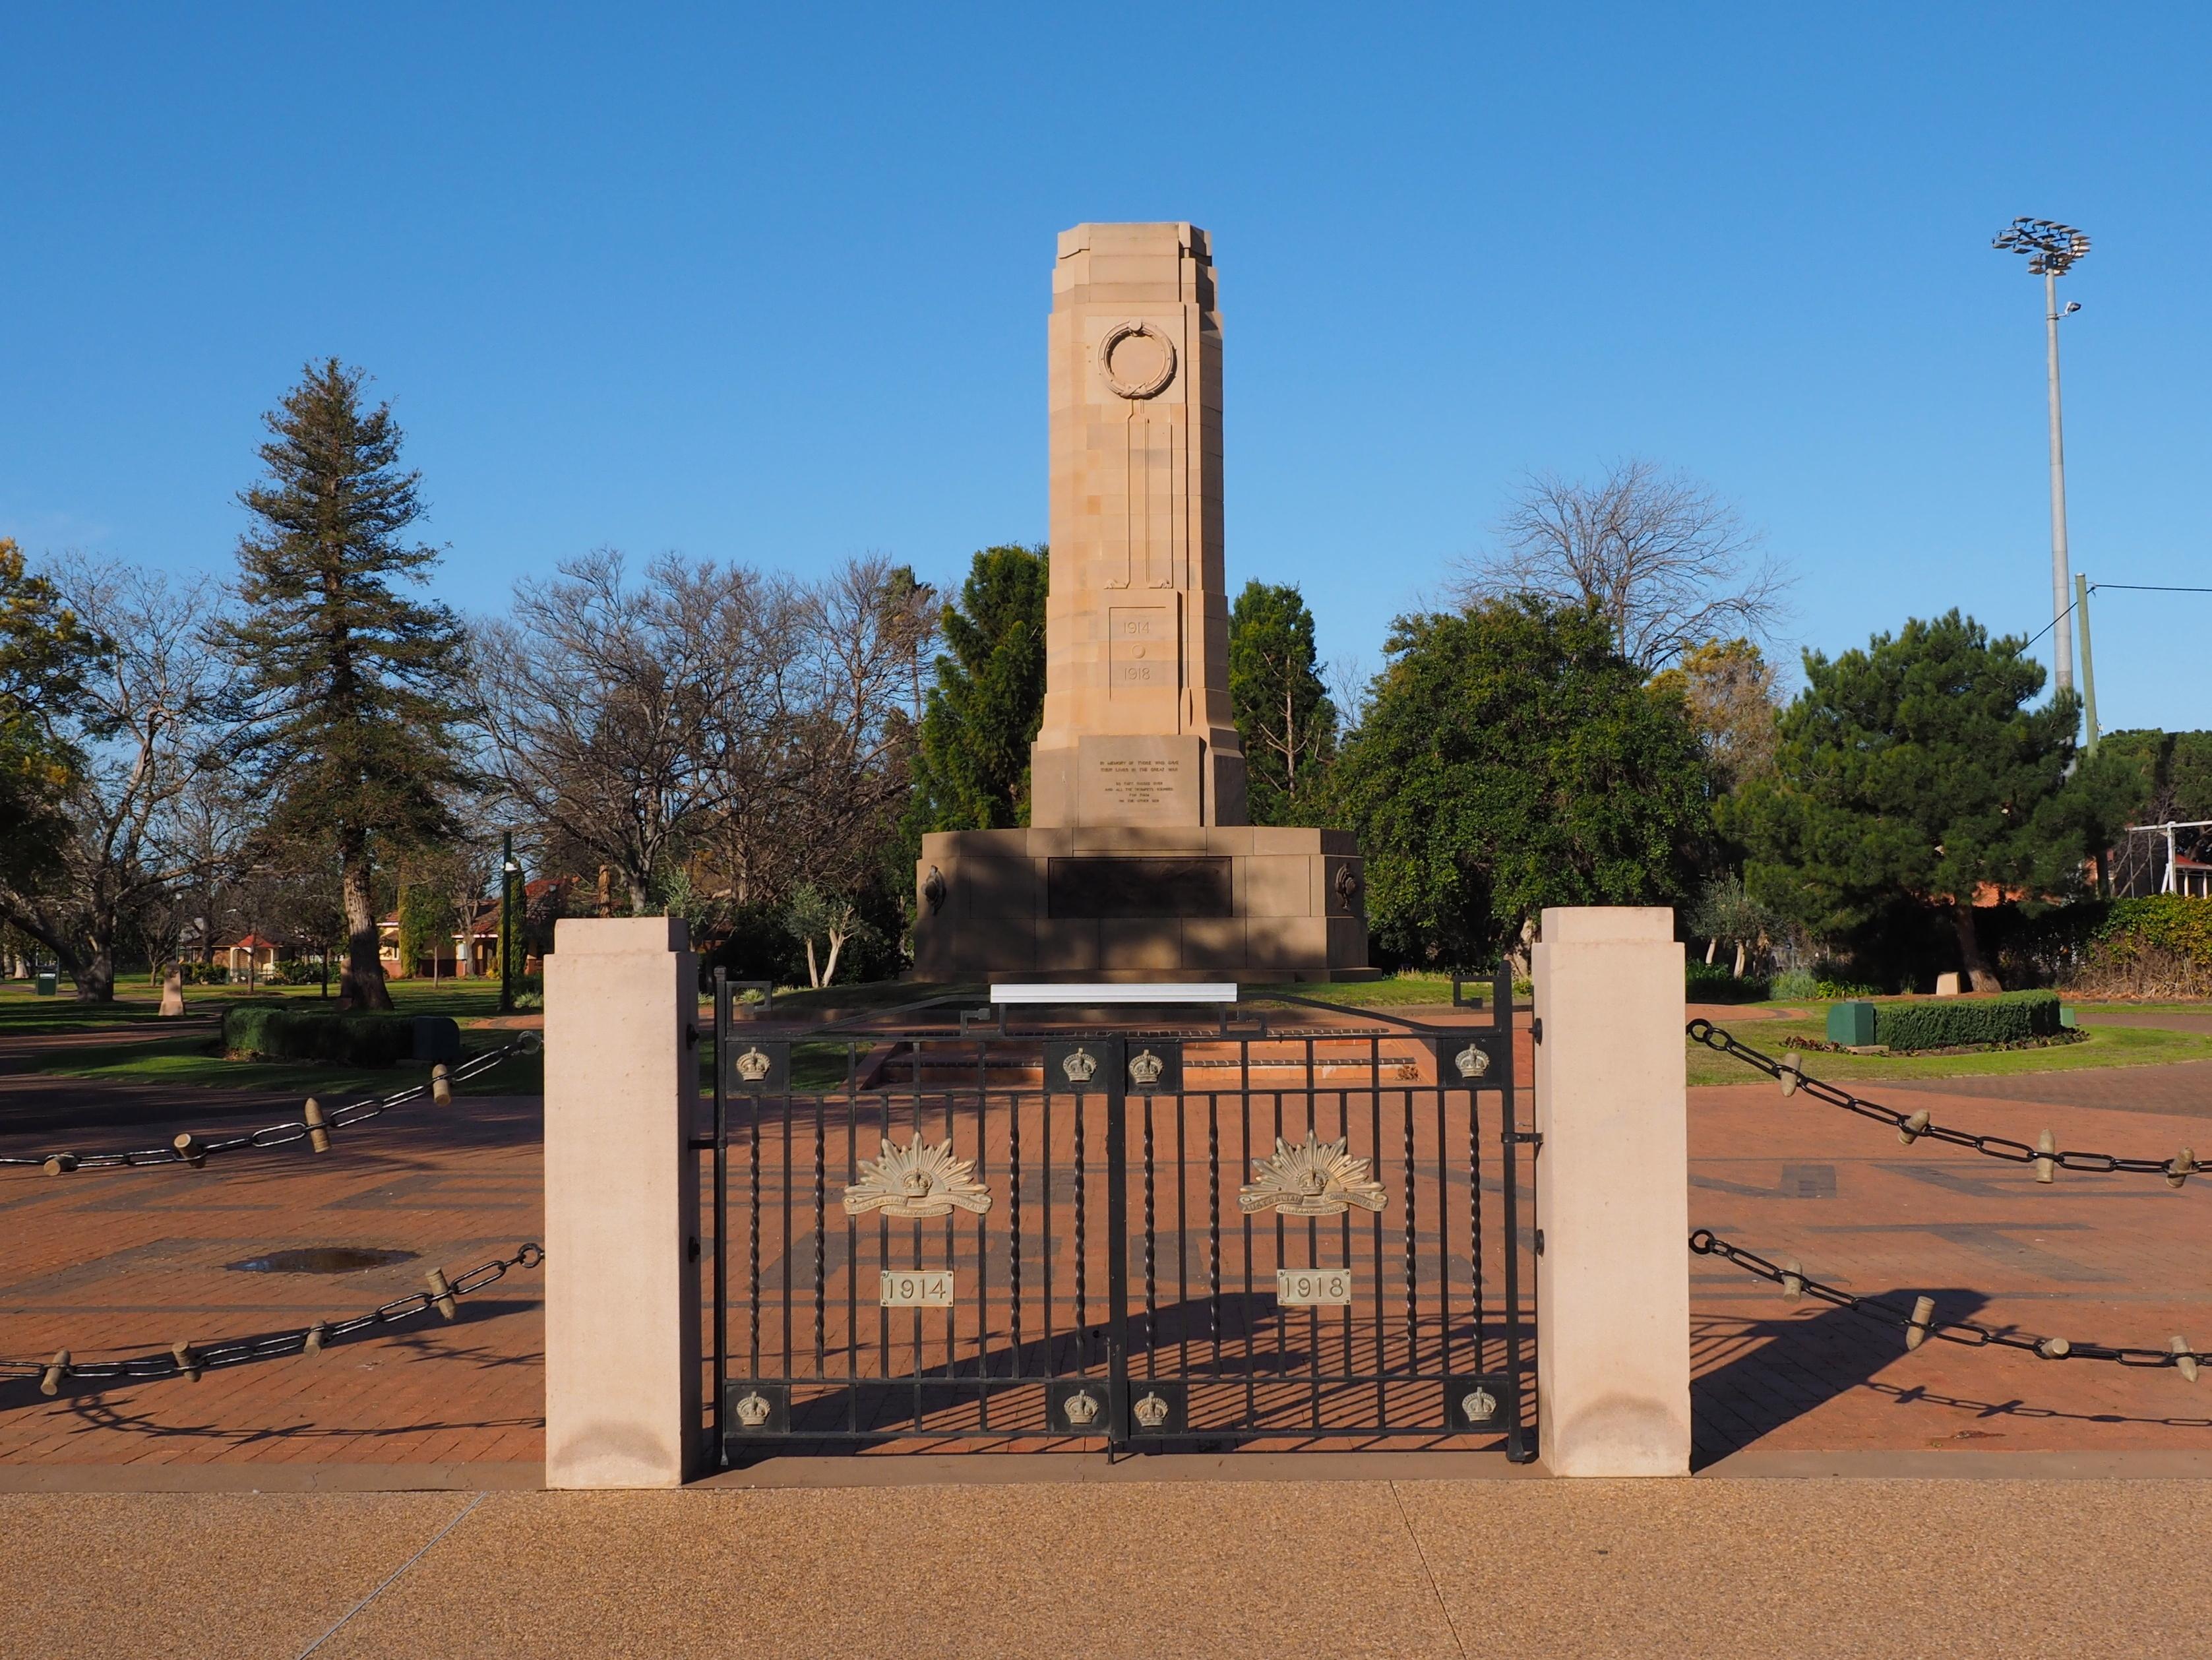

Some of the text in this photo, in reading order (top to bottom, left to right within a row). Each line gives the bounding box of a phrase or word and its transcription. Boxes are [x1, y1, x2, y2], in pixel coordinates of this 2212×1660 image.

[1124, 622, 1150, 634] 1914
[1124, 667, 1151, 680] 1918
[1243, 1194, 1385, 1212] AUSTRALIAN COMMONWEALTH
[1277, 1206, 1314, 1214] MILITARY
[888, 1279, 946, 1299] 1914
[1285, 1277, 1343, 1297] 1918
